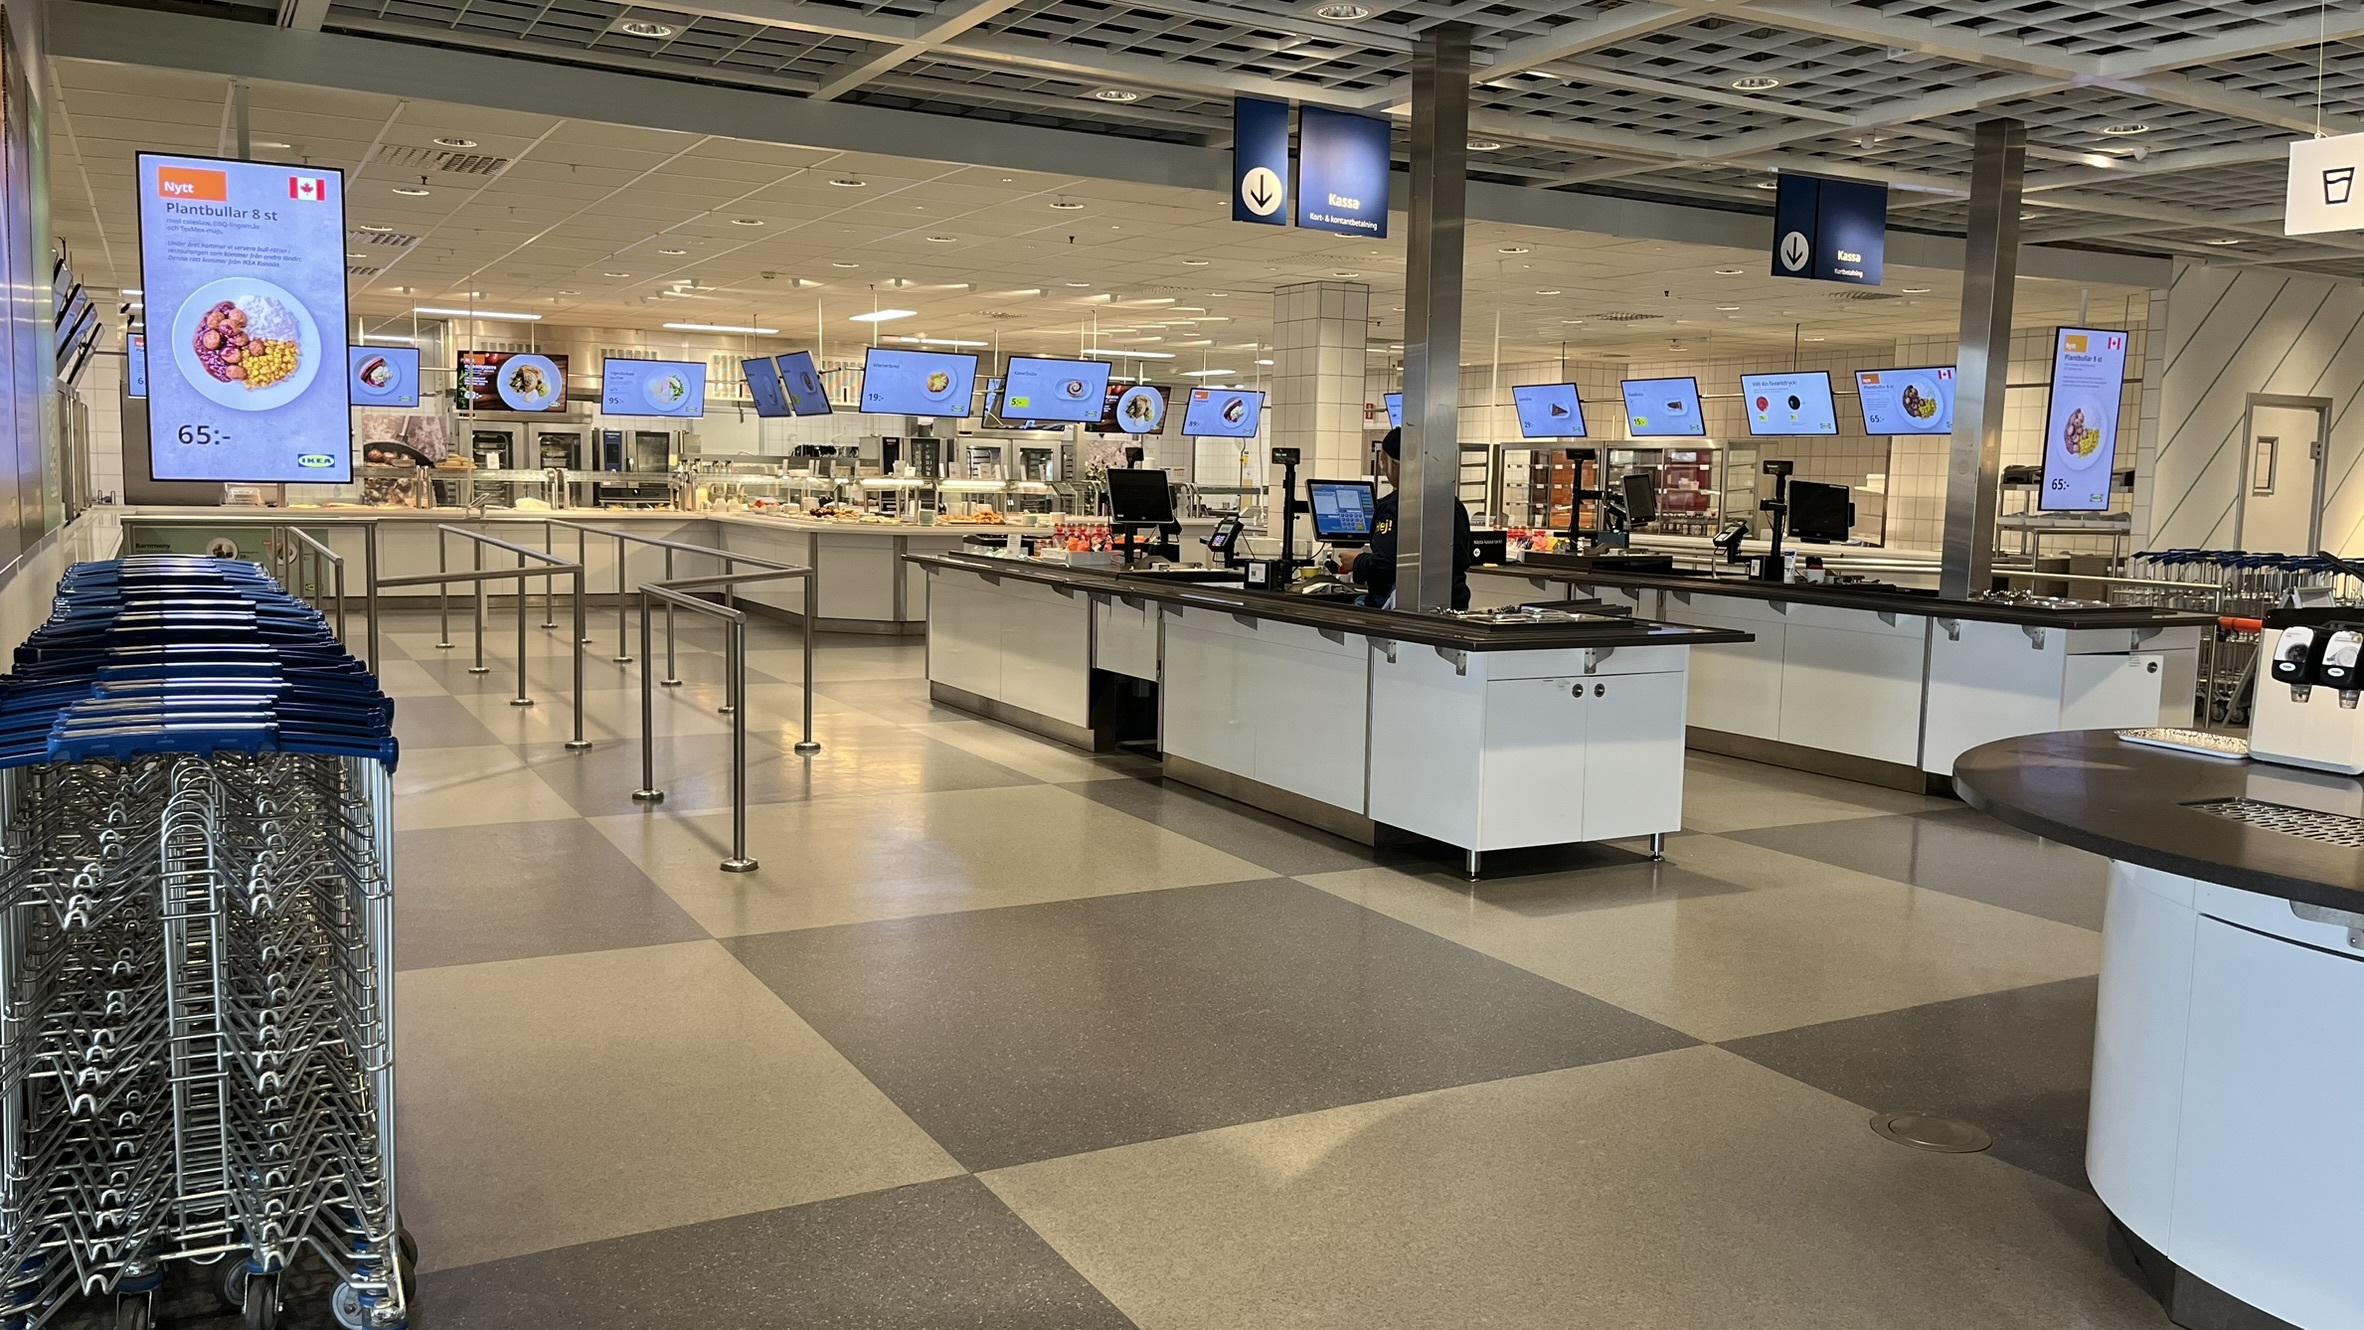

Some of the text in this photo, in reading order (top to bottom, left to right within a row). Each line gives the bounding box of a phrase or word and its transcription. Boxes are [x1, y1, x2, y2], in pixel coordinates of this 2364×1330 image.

[164, 181, 194, 194] Nytt
[1329, 193, 1359, 209] Kassa
[166, 202, 277, 221] Plantbullar 8 st
[1310, 213, 1323, 221] Kort-
[1331, 216, 1377, 231] kontantbetalning
[168, 248, 208, 256] restaurangen
[1838, 250, 1861, 262] Kassa
[1870, 415, 1885, 423] 65:-
[178, 425, 231, 445] 65:-
[2052, 478, 2069, 490] 65:-
